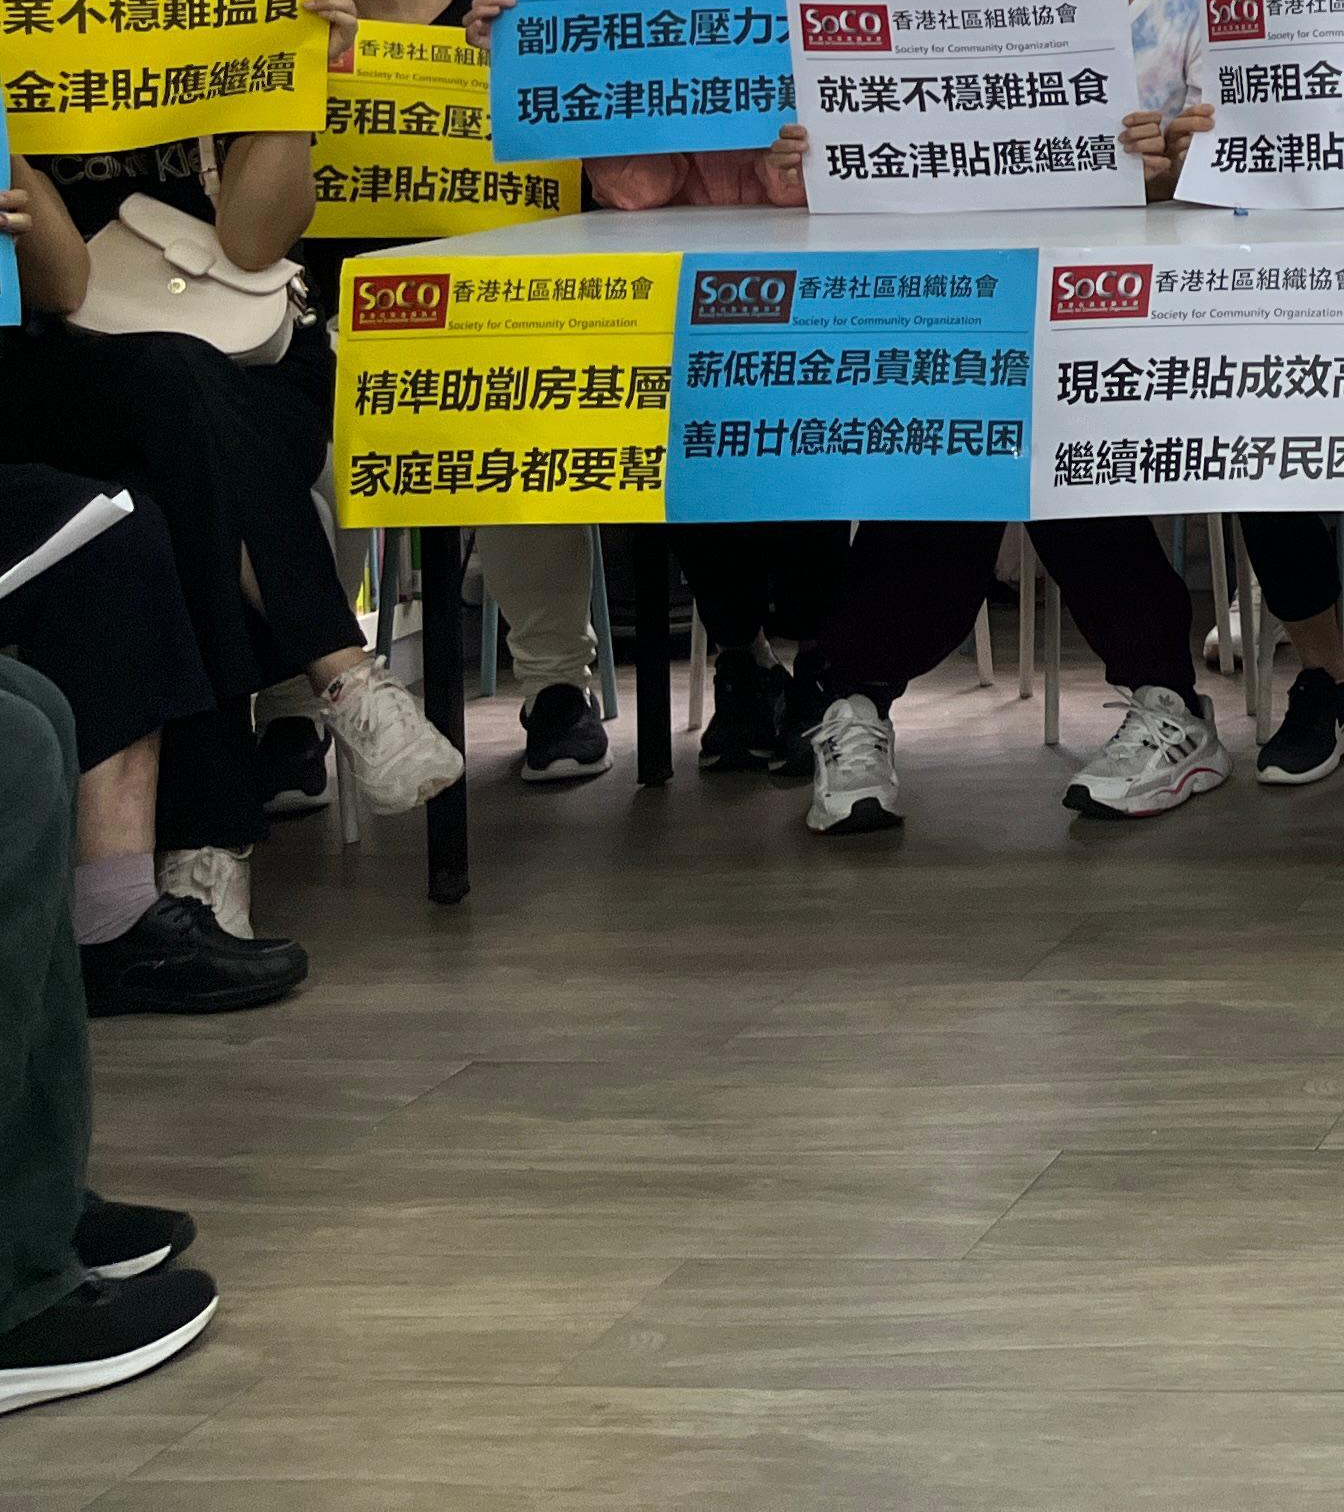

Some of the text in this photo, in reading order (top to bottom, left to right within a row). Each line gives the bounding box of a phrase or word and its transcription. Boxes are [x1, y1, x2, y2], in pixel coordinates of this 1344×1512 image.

[892, 2, 1078, 31] 香港社區組織協會
[895, 40, 1069, 55] Society for Community Organization
[5, 52, 296, 114] 金津貼應繼續
[818, 68, 1108, 113] 就業不穩難搵食
[322, 96, 491, 141] 房租金壓
[826, 134, 1117, 179] 現金津貼應繼續
[313, 164, 561, 213] 金津貼渡時艱
[452, 276, 653, 305] 香港社區組織協會
[798, 270, 999, 301] 香港社區組織協會
[355, 365, 671, 417] 精準助劏房基層
[687, 348, 1030, 390] 薪低租金昂貴難負擔
[683, 419, 1023, 458] 善用廿億結餘解民困
[351, 445, 666, 498] 家庭單身都要幫
